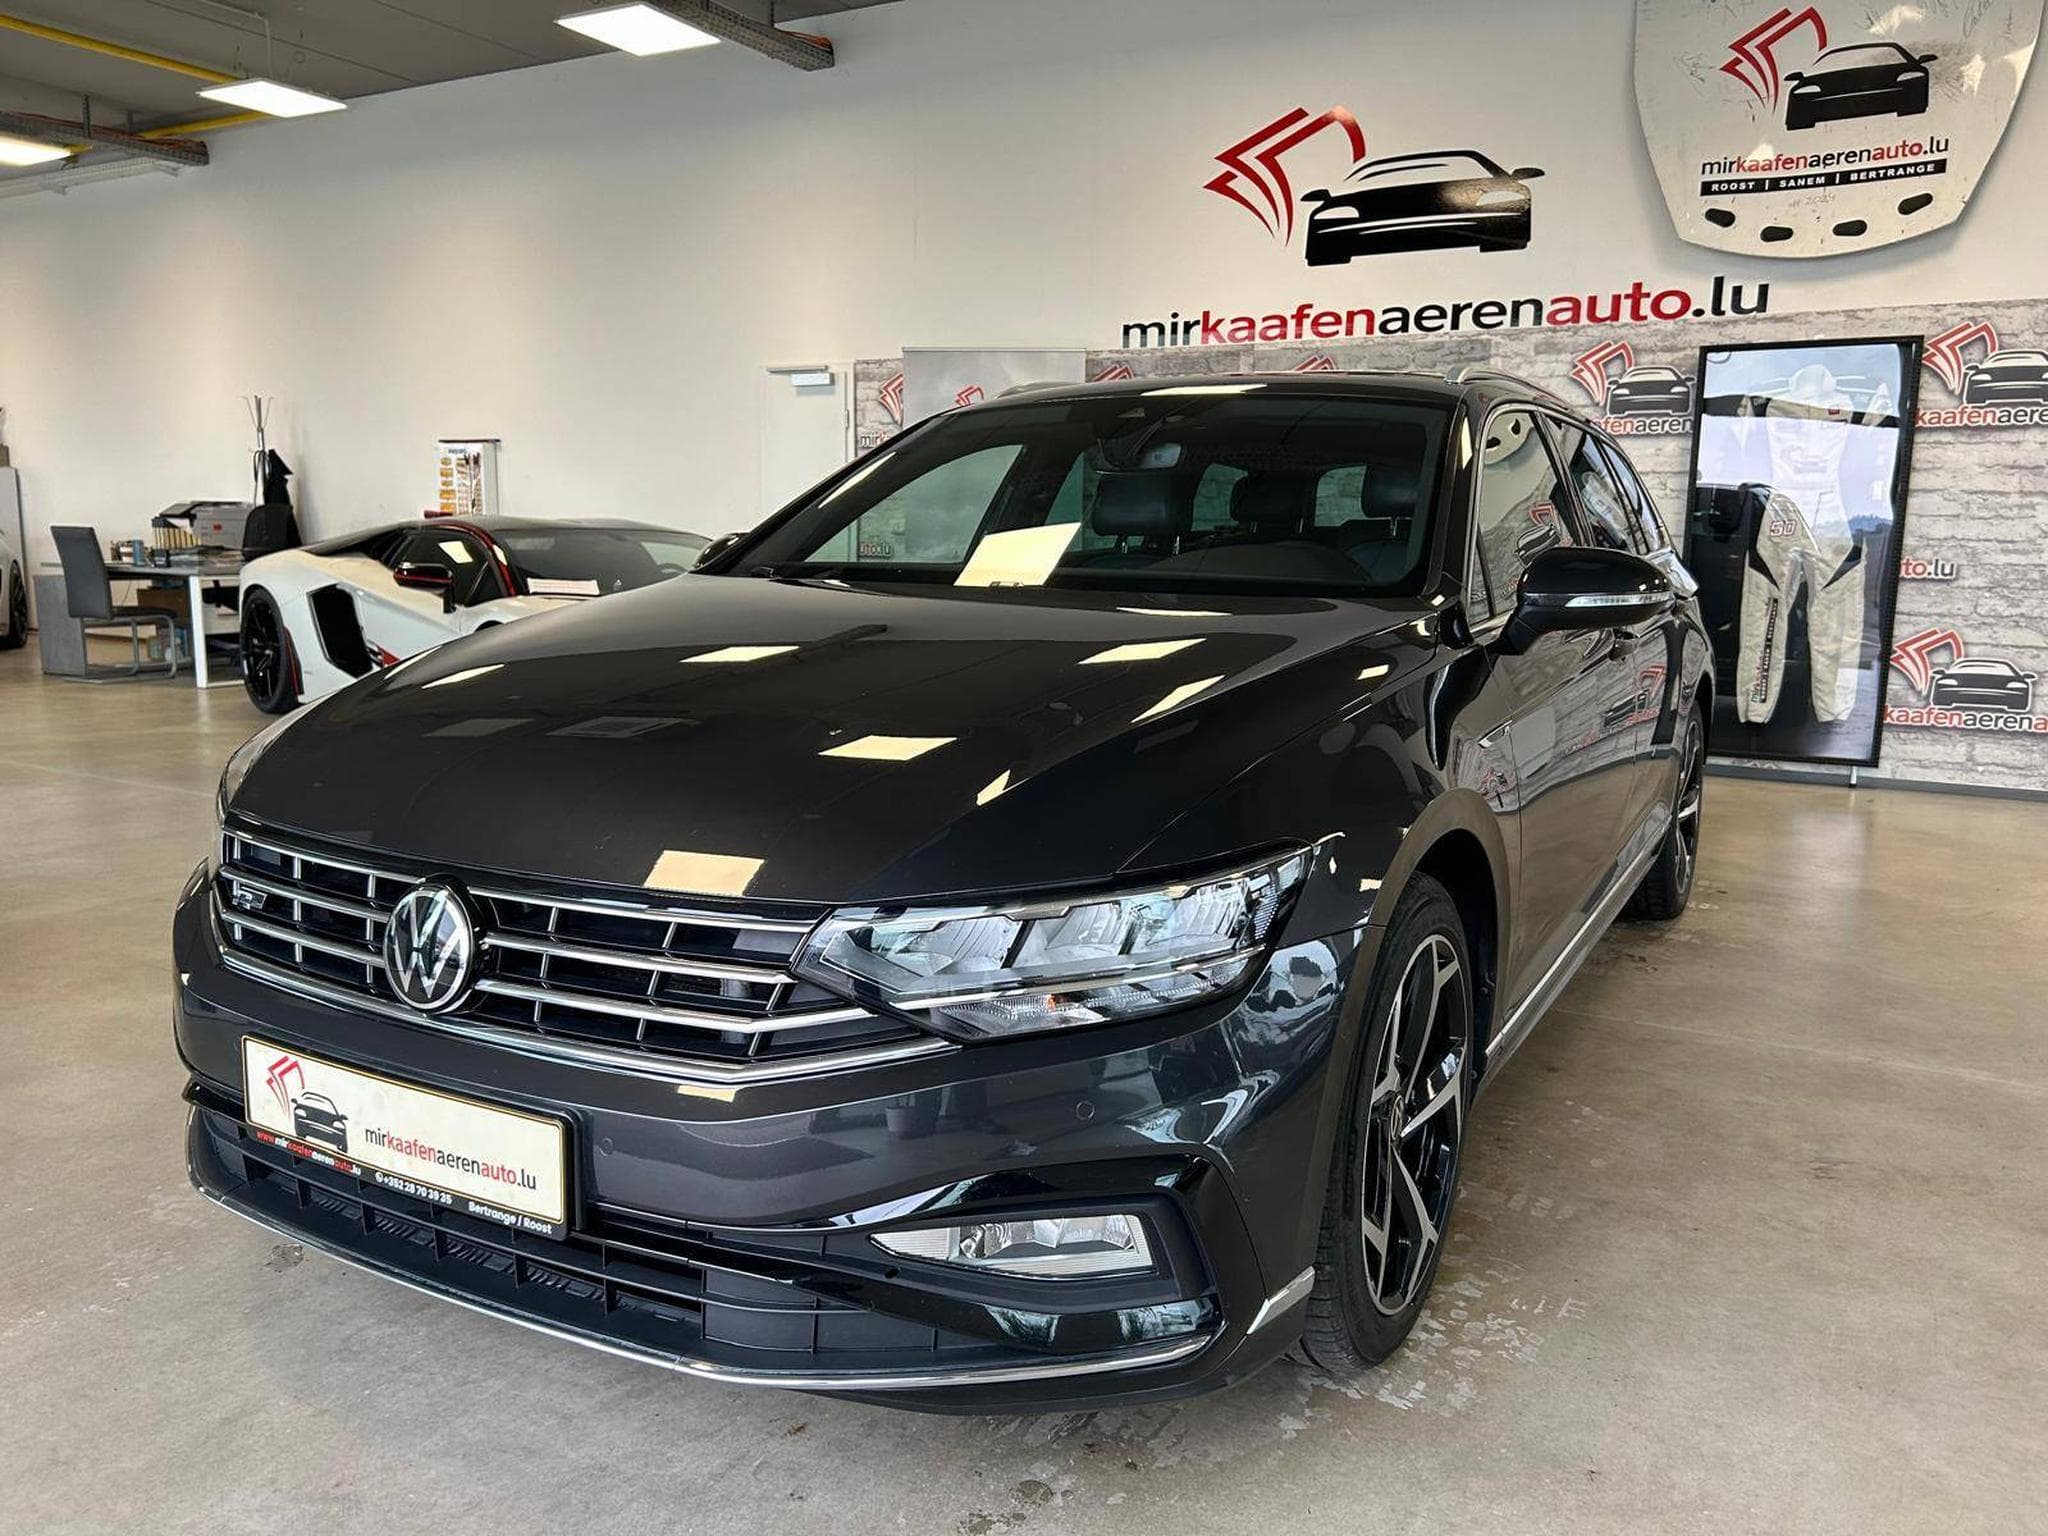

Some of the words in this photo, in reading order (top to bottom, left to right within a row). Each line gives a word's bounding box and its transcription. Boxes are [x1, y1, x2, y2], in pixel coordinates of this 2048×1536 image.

[1700, 136, 1949, 175] mirkaafenaerenauto.lu
[1711, 181, 1755, 192] ROOST
[1779, 176, 1826, 188] SANEM
[1850, 163, 1936, 181] BERTRANGE
[1121, 275, 1769, 349] mirkaafenaerenauto.lu
[365, 1127, 537, 1190] mirkaafenaerenauto.lu
[468, 1201, 517, 1226] Bertrange
[523, 1217, 552, 1235] Roost
